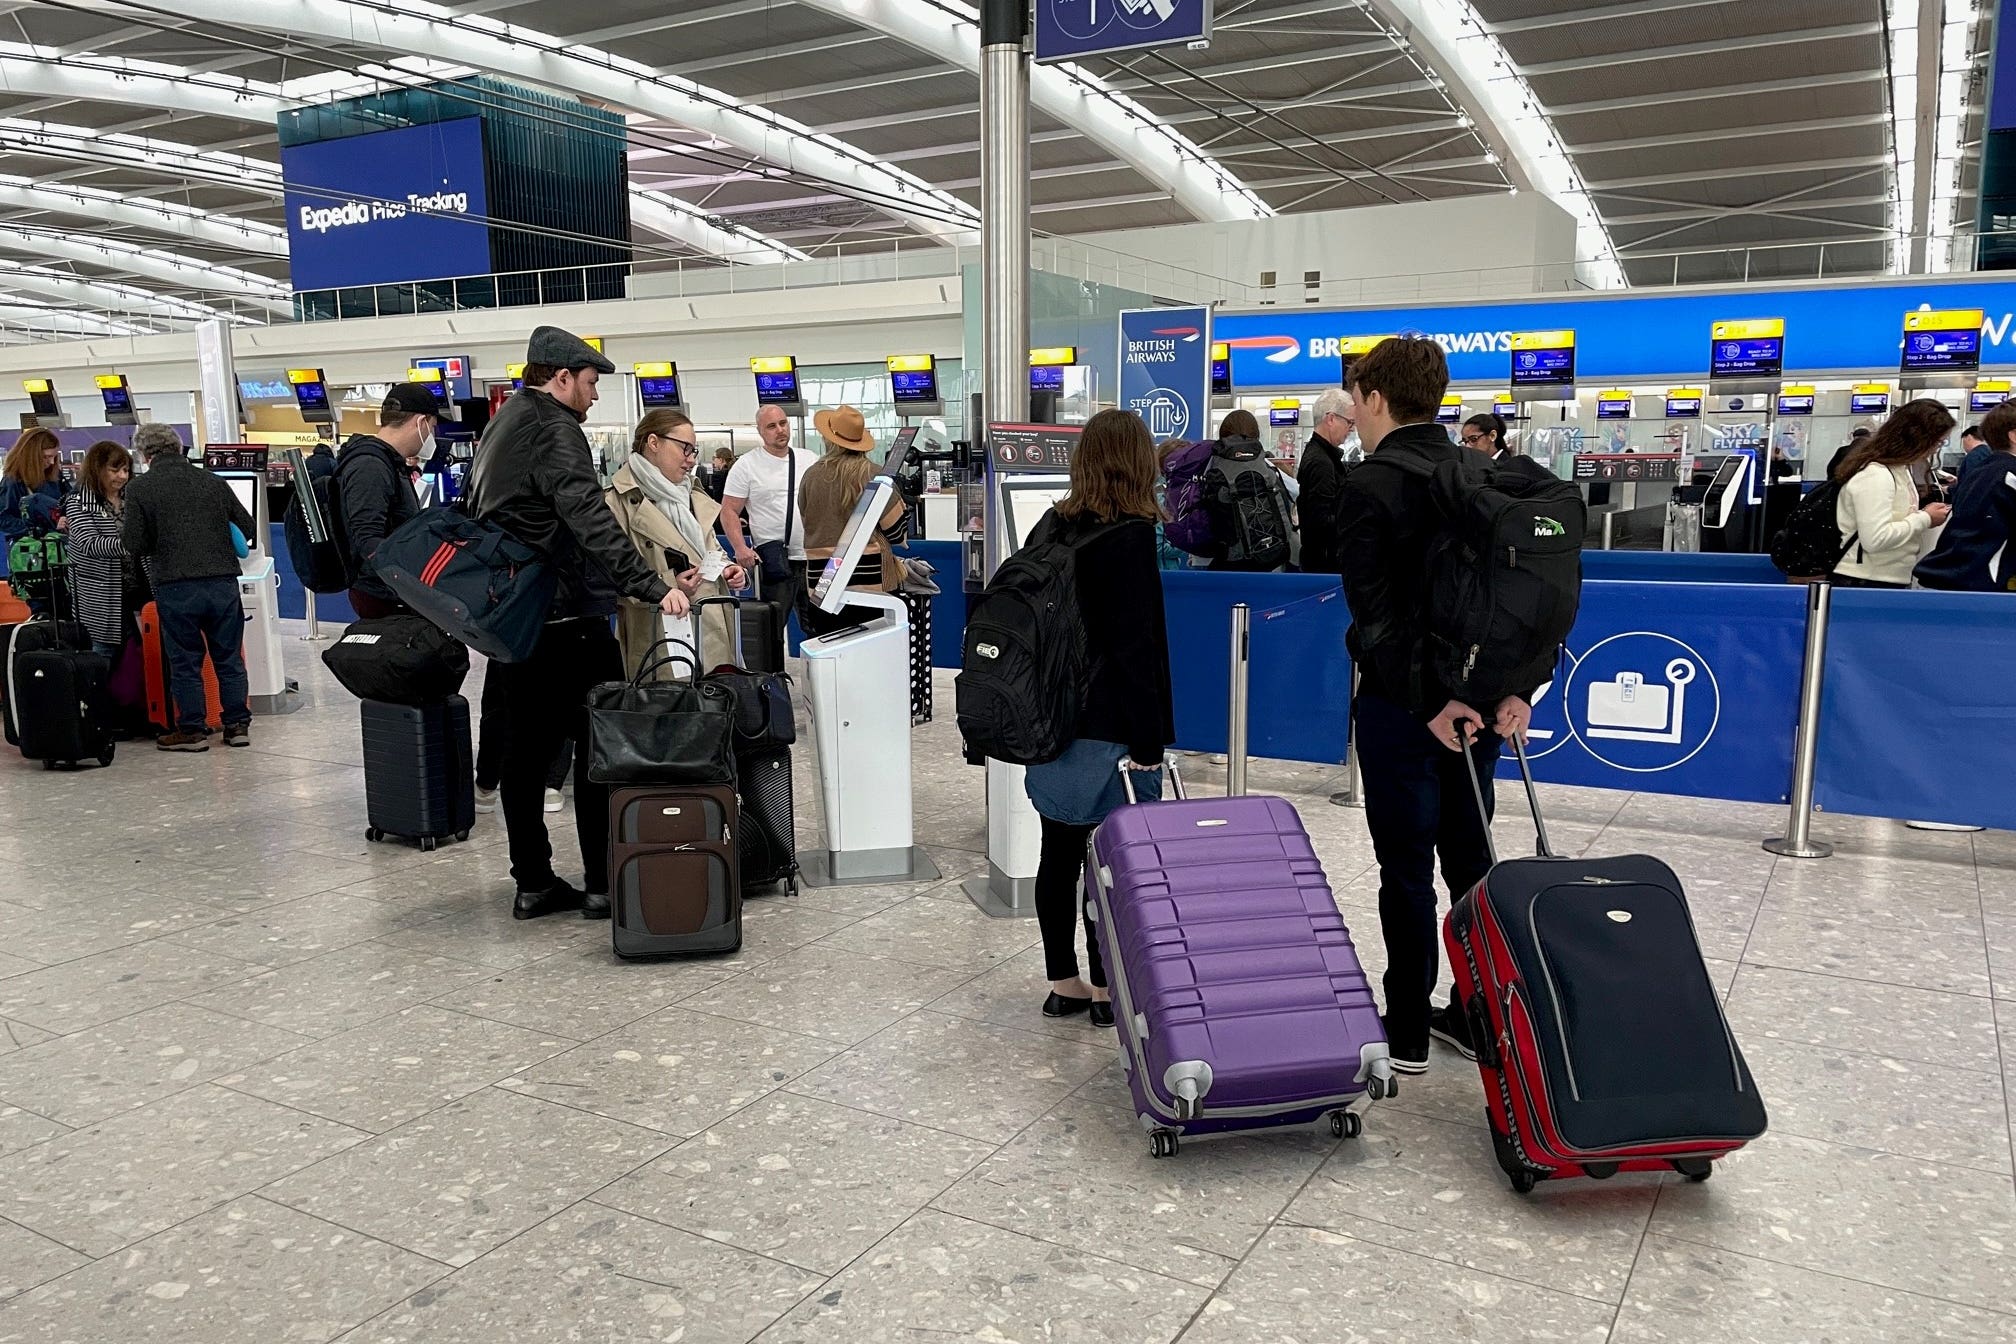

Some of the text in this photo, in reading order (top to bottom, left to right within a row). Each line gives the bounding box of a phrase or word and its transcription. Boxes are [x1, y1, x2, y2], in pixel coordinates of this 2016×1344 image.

[300, 191, 467, 233] Expedia Price Tracking
[1129, 339, 1175, 352] BRITISH
[1126, 351, 1176, 364] AIRWAYS
[1130, 398, 1153, 408] STEP
